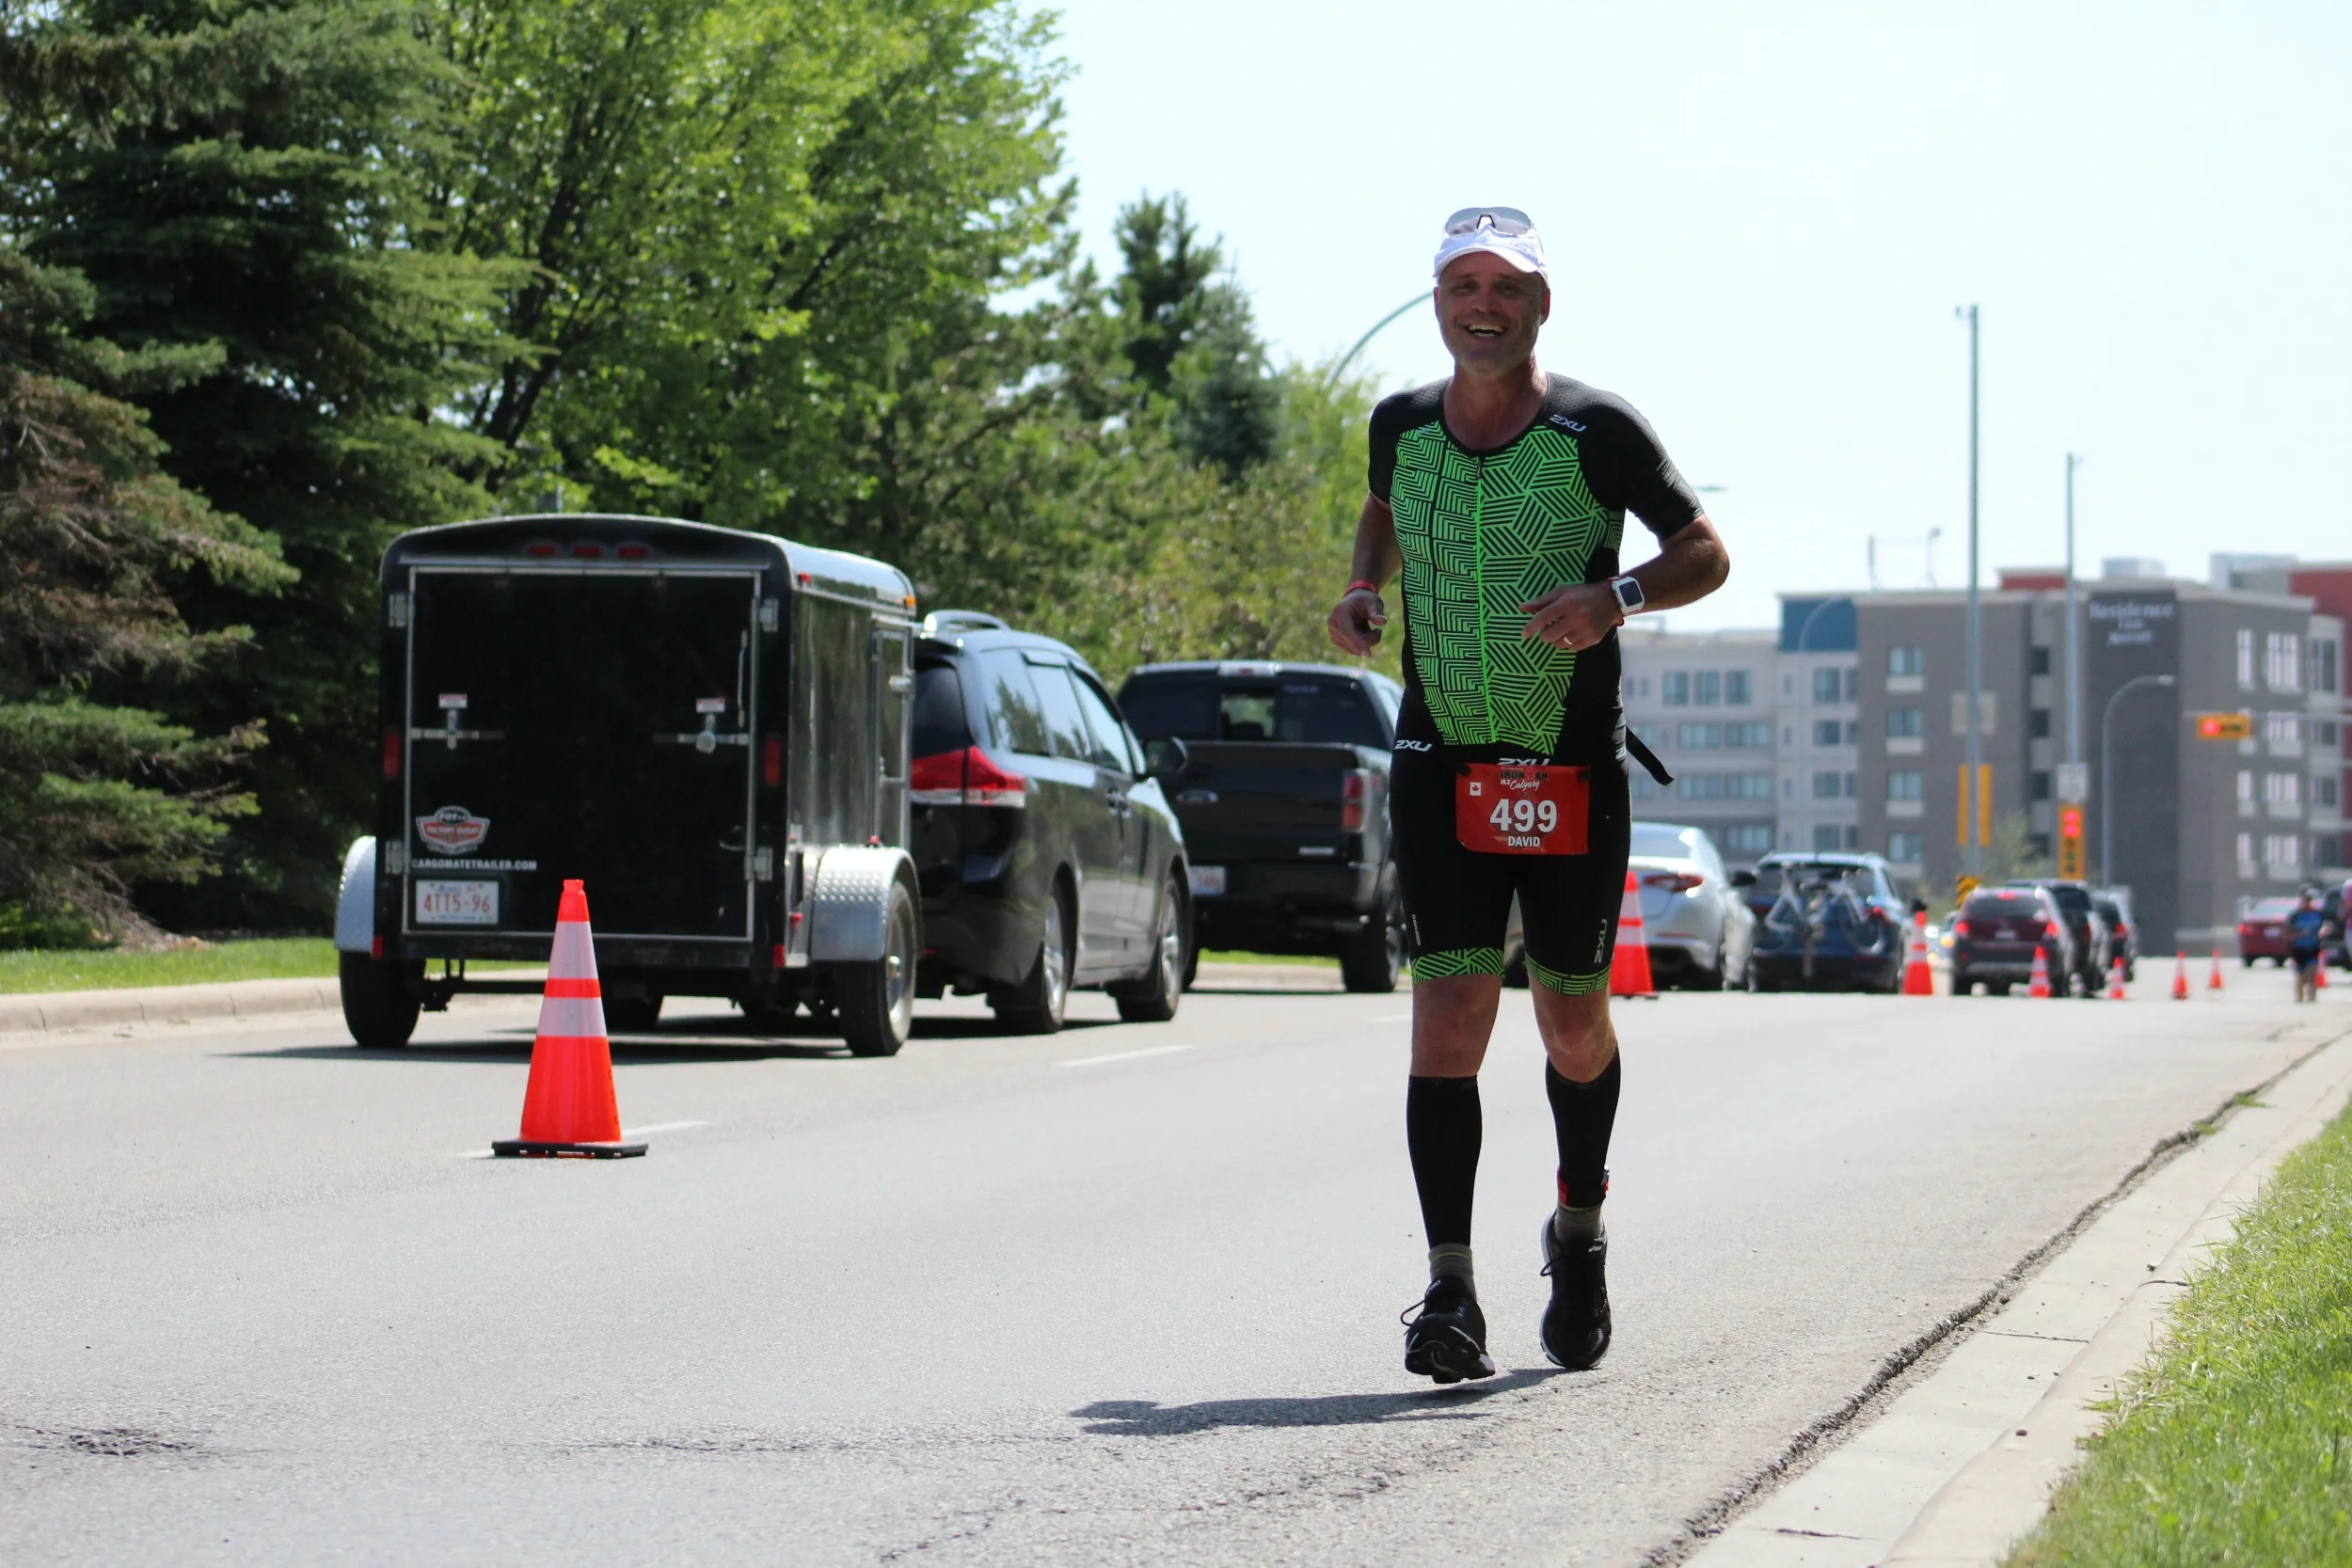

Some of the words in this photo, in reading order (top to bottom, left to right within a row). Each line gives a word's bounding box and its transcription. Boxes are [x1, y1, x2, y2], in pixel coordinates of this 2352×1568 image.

[1549, 414, 1586, 432] 2XU
[1394, 739, 1432, 752] 2XU
[1498, 757, 1550, 766] 2XU
[1510, 779, 1540, 791] Calgary
[1489, 799, 1557, 832] 499
[1508, 835, 1540, 847] DAVID
[412, 858, 537, 870] CARGOMATETRAILER.COM
[423, 893, 491, 913] 4TT5-96
[1595, 919, 1607, 963] 2XU
